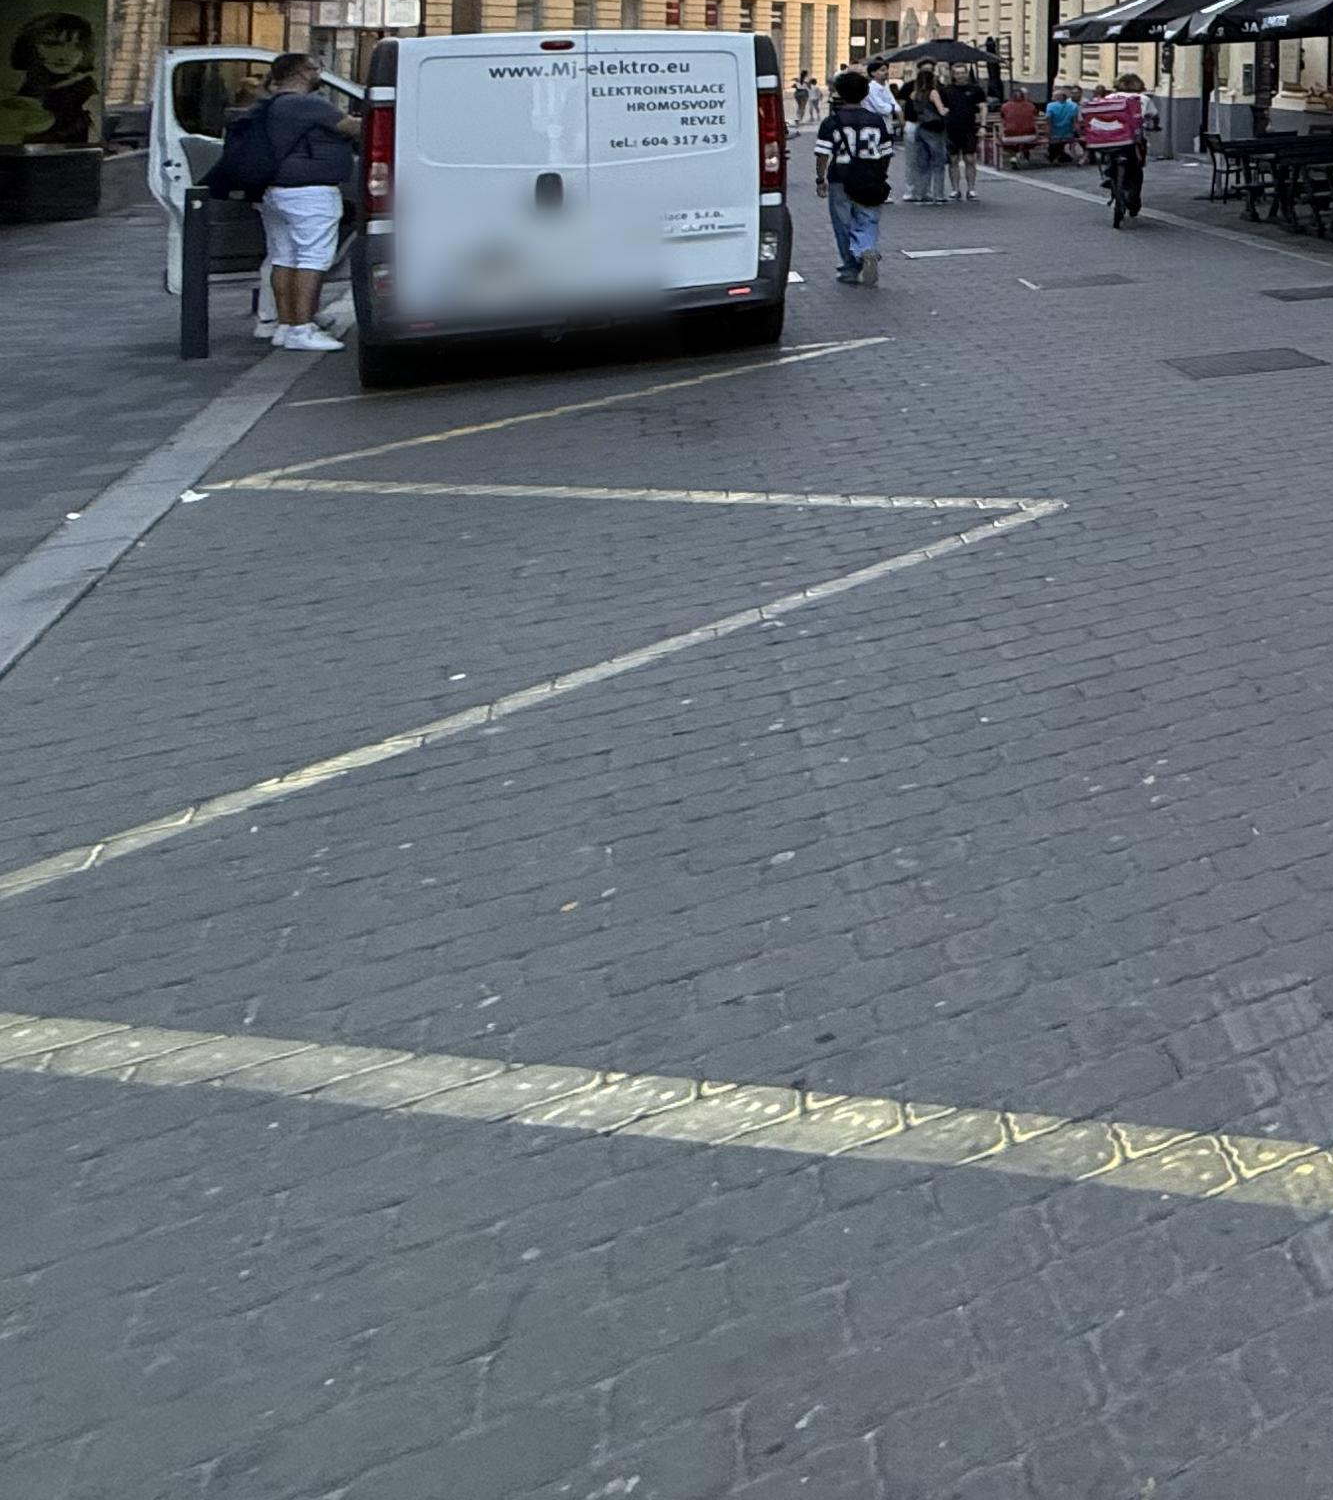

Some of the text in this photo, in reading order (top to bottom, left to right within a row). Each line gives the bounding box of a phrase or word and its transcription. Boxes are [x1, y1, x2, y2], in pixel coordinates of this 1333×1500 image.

[489, 61, 690, 79] www.Mj-elektro.eu
[591, 83, 726, 98] ELEKTROINSTALACE
[627, 99, 727, 113] HROMOSVODY
[680, 114, 727, 127] REVIZE
[642, 135, 669, 148] 604
[673, 134, 699, 147] 317
[702, 133, 728, 146] 433
